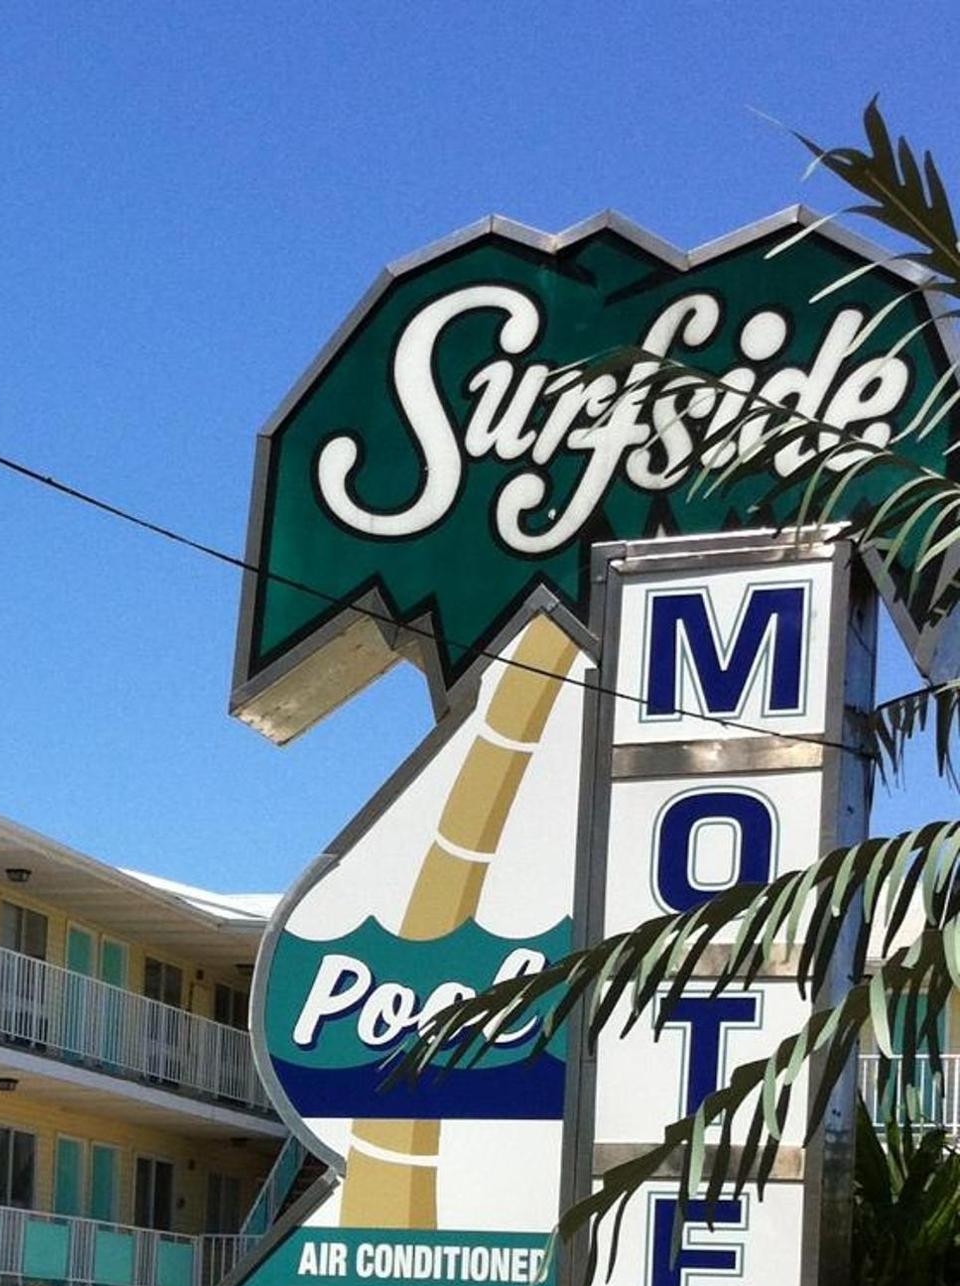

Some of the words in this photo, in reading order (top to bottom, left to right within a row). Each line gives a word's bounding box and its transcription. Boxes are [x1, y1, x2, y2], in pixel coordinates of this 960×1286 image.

[318, 285, 908, 553] Surfside
[298, 1242, 347, 1277] AIR
[355, 1243, 548, 1283] CONDITIONED
